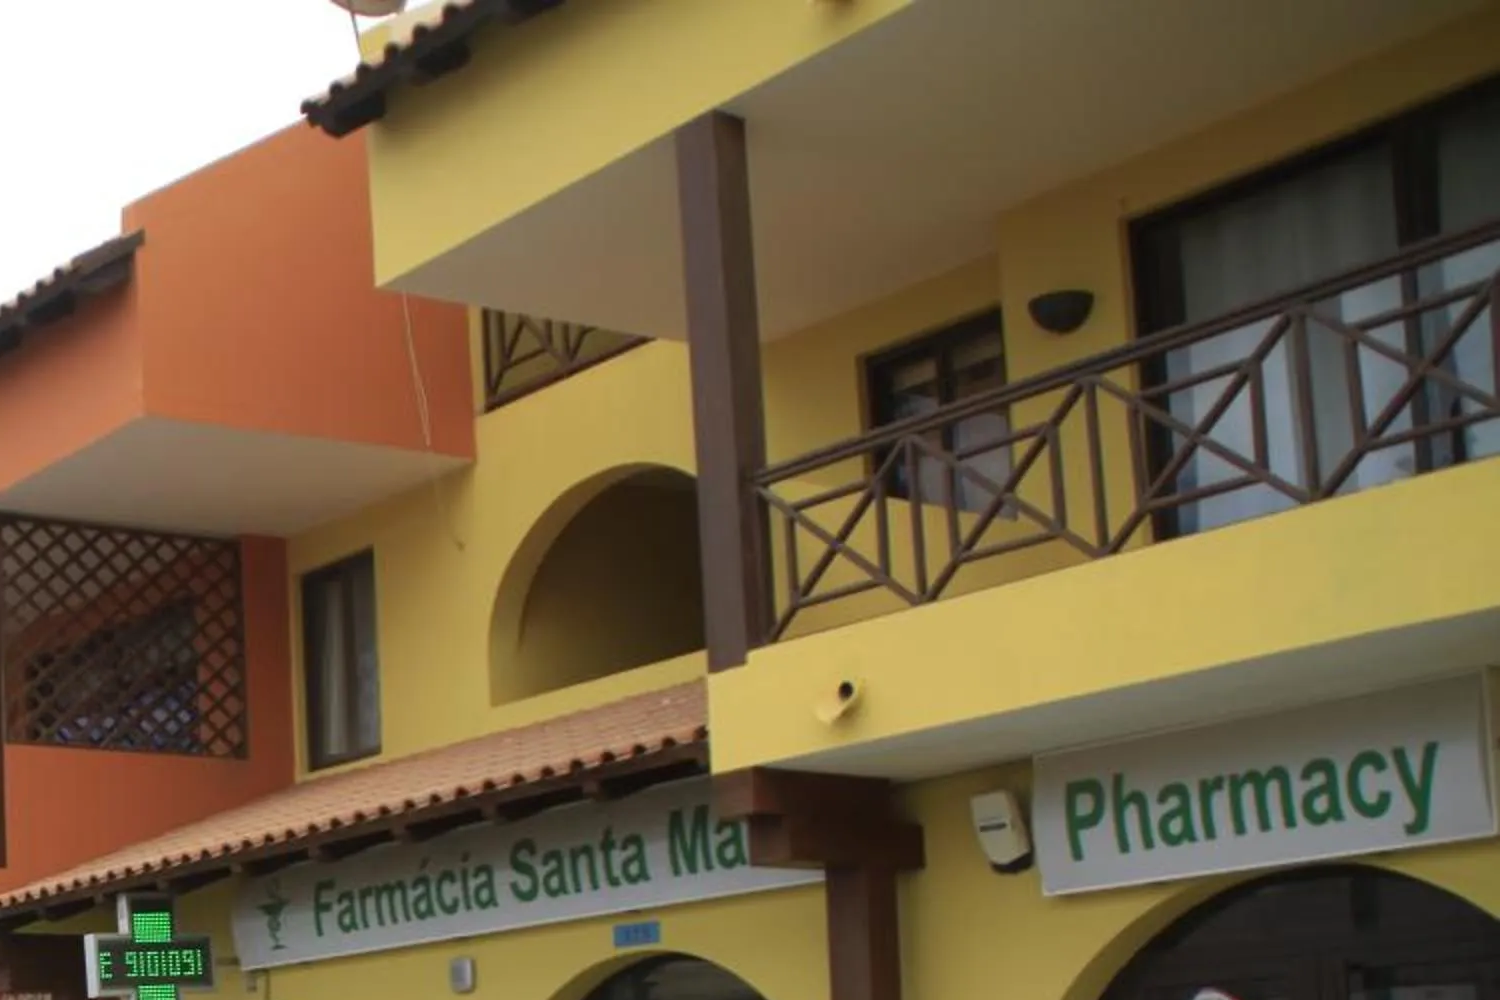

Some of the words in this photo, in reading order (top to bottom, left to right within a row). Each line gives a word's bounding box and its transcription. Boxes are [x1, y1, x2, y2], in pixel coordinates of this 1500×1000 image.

[1065, 742, 1439, 861] Pharmacy
[314, 853, 499, 937] Farmácia
[509, 826, 651, 903] Santa
[668, 804, 748, 877] Ma
